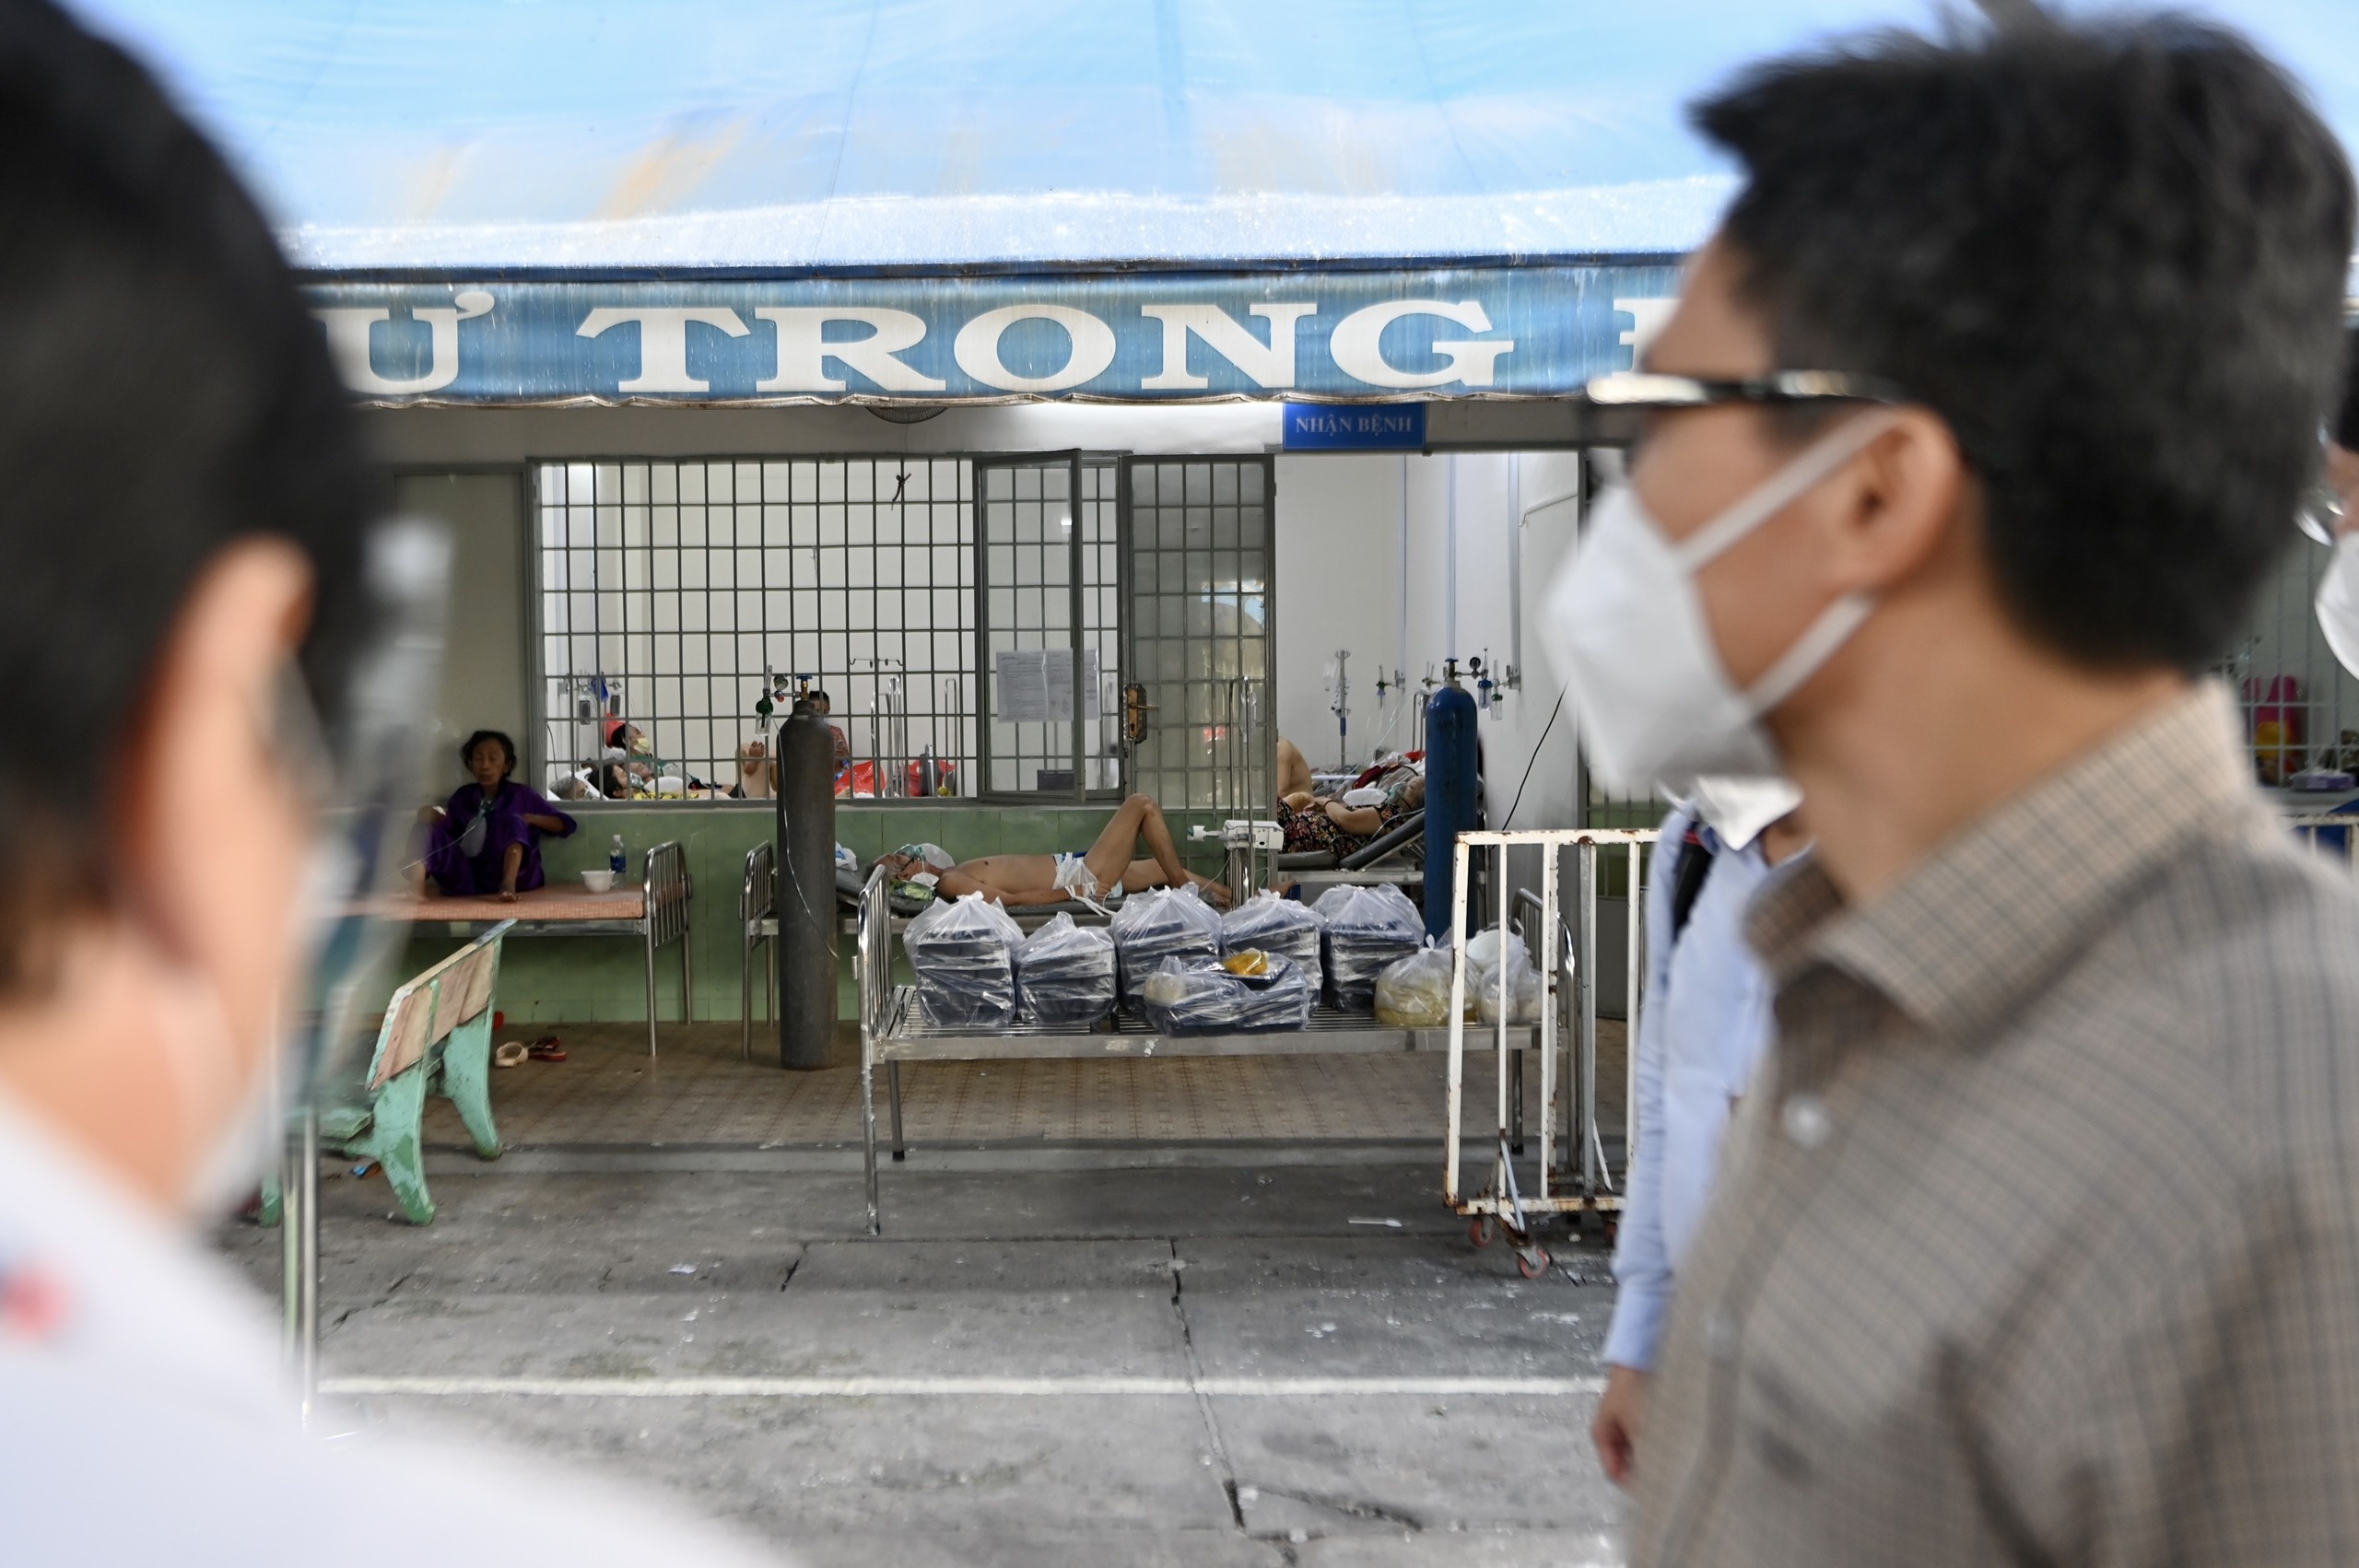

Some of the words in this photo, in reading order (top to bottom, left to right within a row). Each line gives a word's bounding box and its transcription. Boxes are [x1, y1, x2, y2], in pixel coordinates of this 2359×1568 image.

[576, 300, 1513, 393] TRONG
[1296, 415, 1352, 437] NHẬN
[1358, 414, 1412, 436] BỆNH
